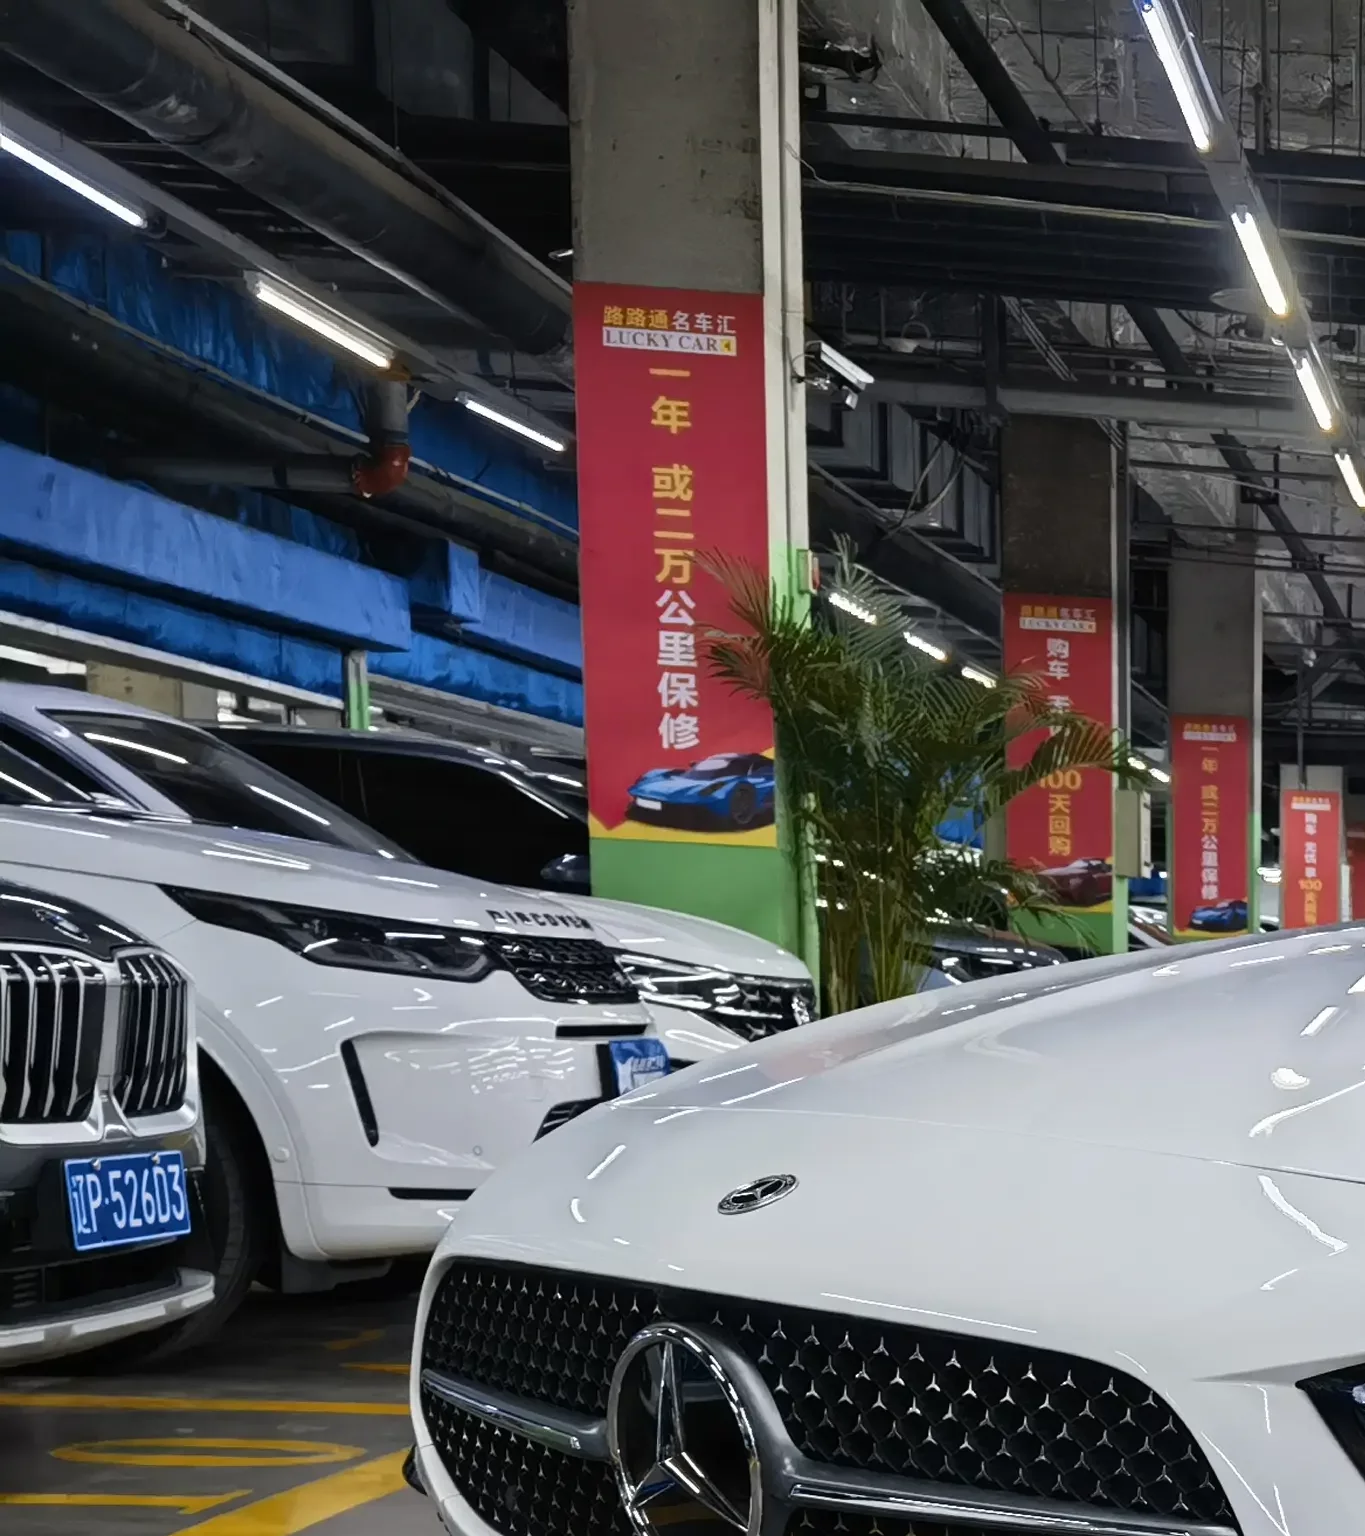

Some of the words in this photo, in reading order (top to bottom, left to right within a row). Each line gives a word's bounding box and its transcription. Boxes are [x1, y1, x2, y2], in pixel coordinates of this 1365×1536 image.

[603, 305, 737, 334] 路路通名车汇
[605, 328, 672, 349] LUCKY
[678, 335, 719, 352] CAR
